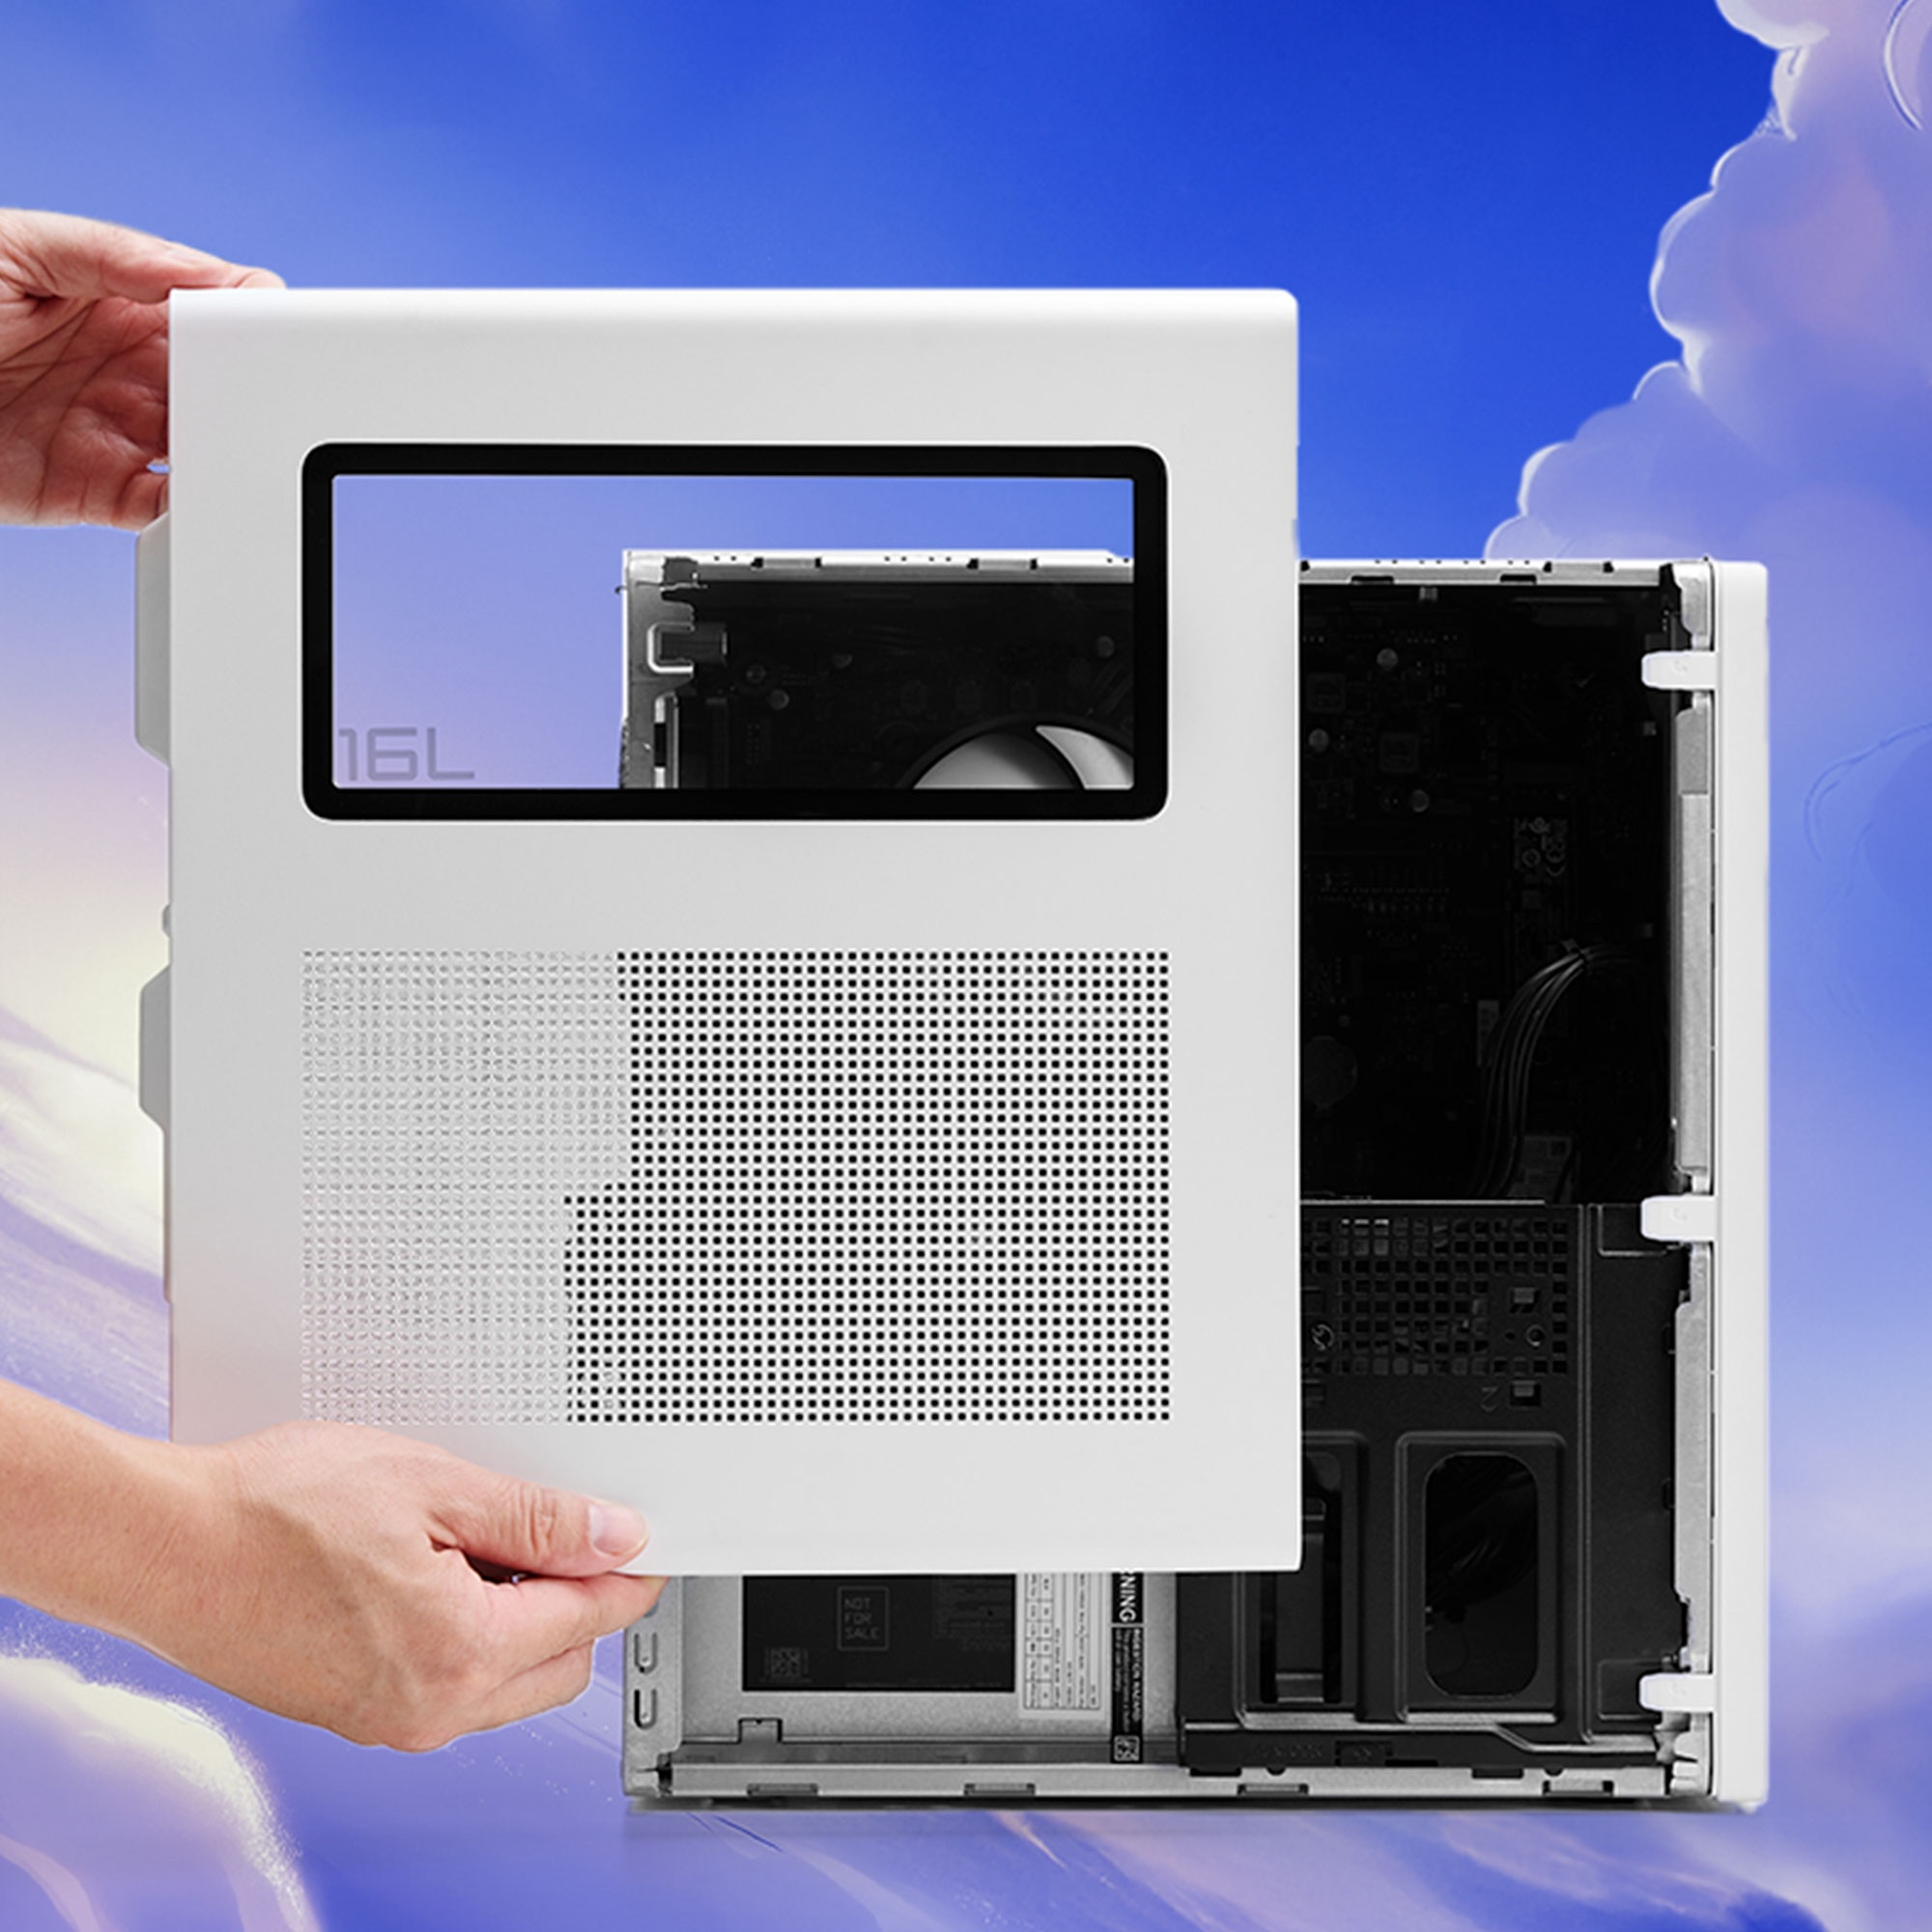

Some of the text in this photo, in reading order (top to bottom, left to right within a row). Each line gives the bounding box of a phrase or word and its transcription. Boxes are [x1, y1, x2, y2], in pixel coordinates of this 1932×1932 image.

[339, 726, 475, 781] 16L
[844, 1597, 871, 1610] NOT
[844, 1611, 872, 1626] FOR
[844, 1627, 880, 1640] SALE
